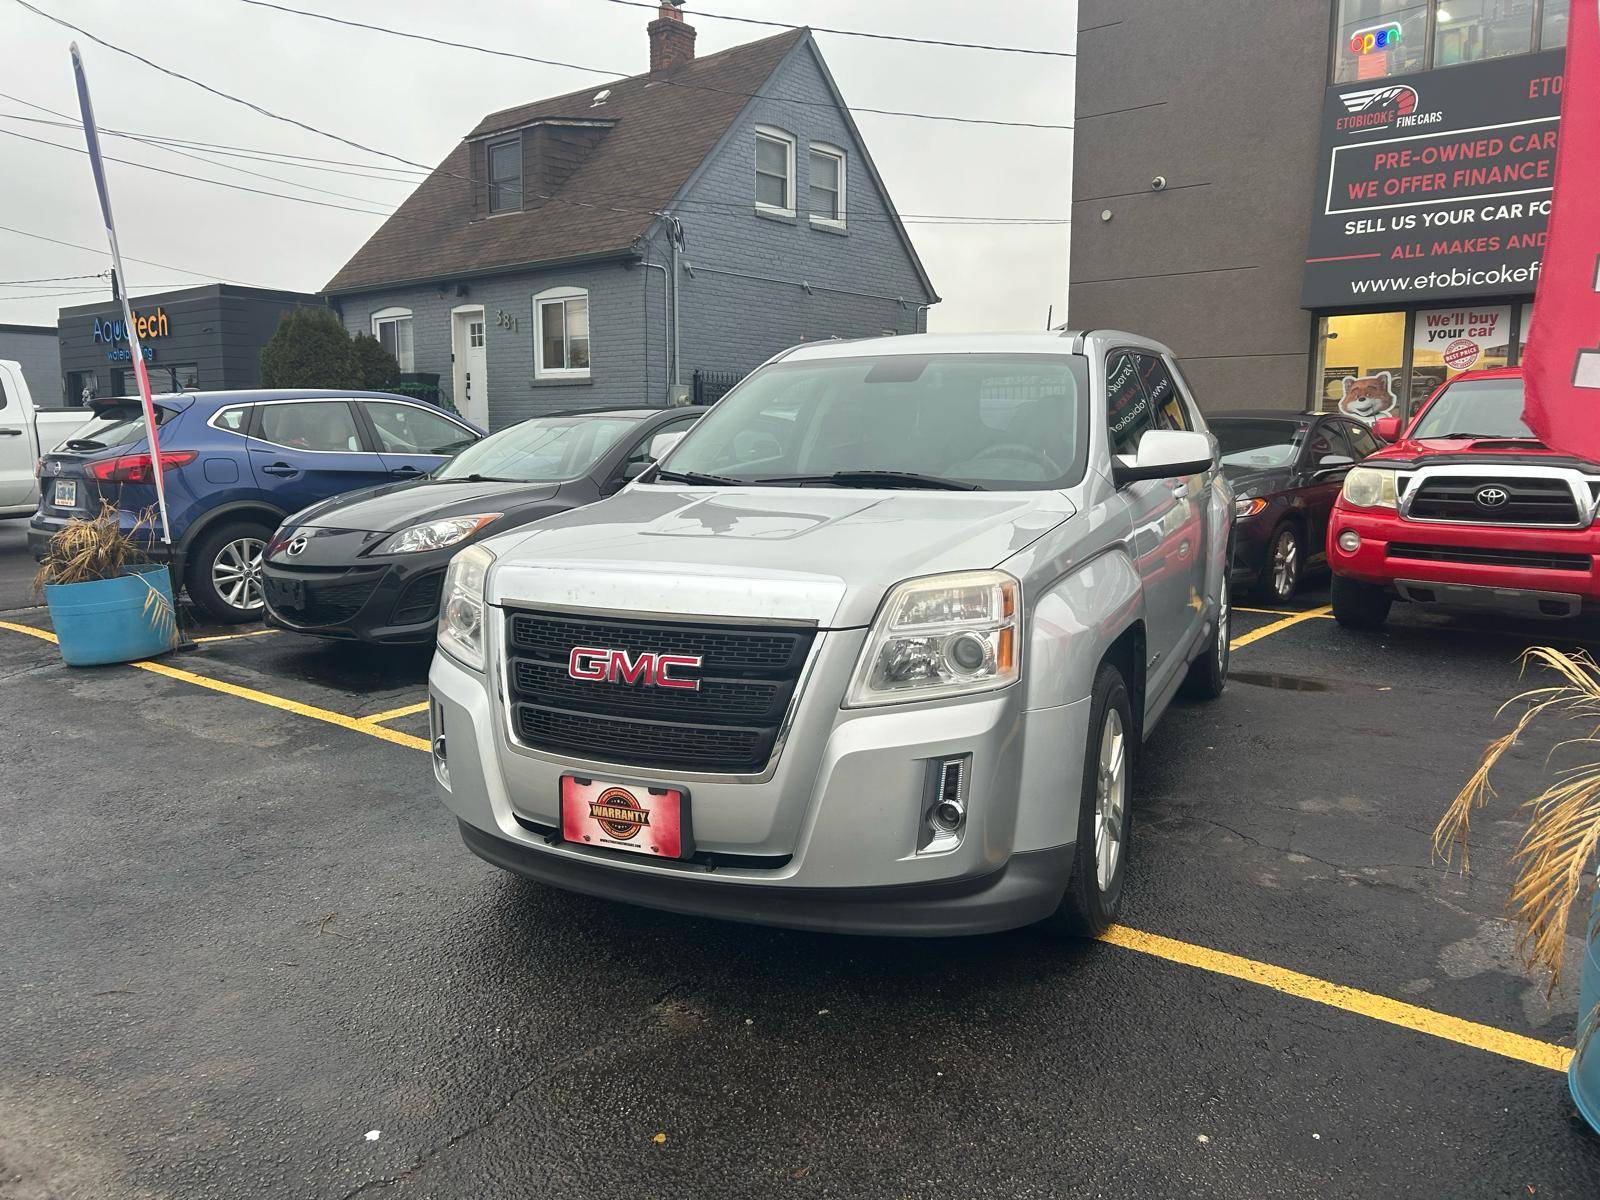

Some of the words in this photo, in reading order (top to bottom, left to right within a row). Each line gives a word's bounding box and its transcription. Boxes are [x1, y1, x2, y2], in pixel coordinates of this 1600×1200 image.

[1350, 27, 1401, 54] open
[1336, 110, 1394, 130] ETOBICOKE
[1396, 115, 1417, 128] FINE
[1417, 111, 1443, 125] CARS
[1374, 138, 1503, 171] PRE-OWNED
[1348, 180, 1378, 200] WE
[1383, 172, 1447, 196] OFFER
[1452, 160, 1550, 188] FINANCE
[1344, 219, 1386, 235] SELL
[1391, 213, 1417, 230] US
[1422, 208, 1476, 228] YOUR
[1480, 203, 1523, 222] CAR
[1390, 243, 1425, 260] ALL
[1430, 236, 1500, 257] MAKES
[1506, 232, 1549, 250] AND
[495, 310, 519, 333] 381
[1426, 312, 1465, 327] We'll
[1468, 312, 1499, 327] buy
[1428, 328, 1465, 342] your
[1468, 326, 1496, 338] car
[568, 646, 703, 691] GMC
[592, 805, 647, 822] WARRANTY
